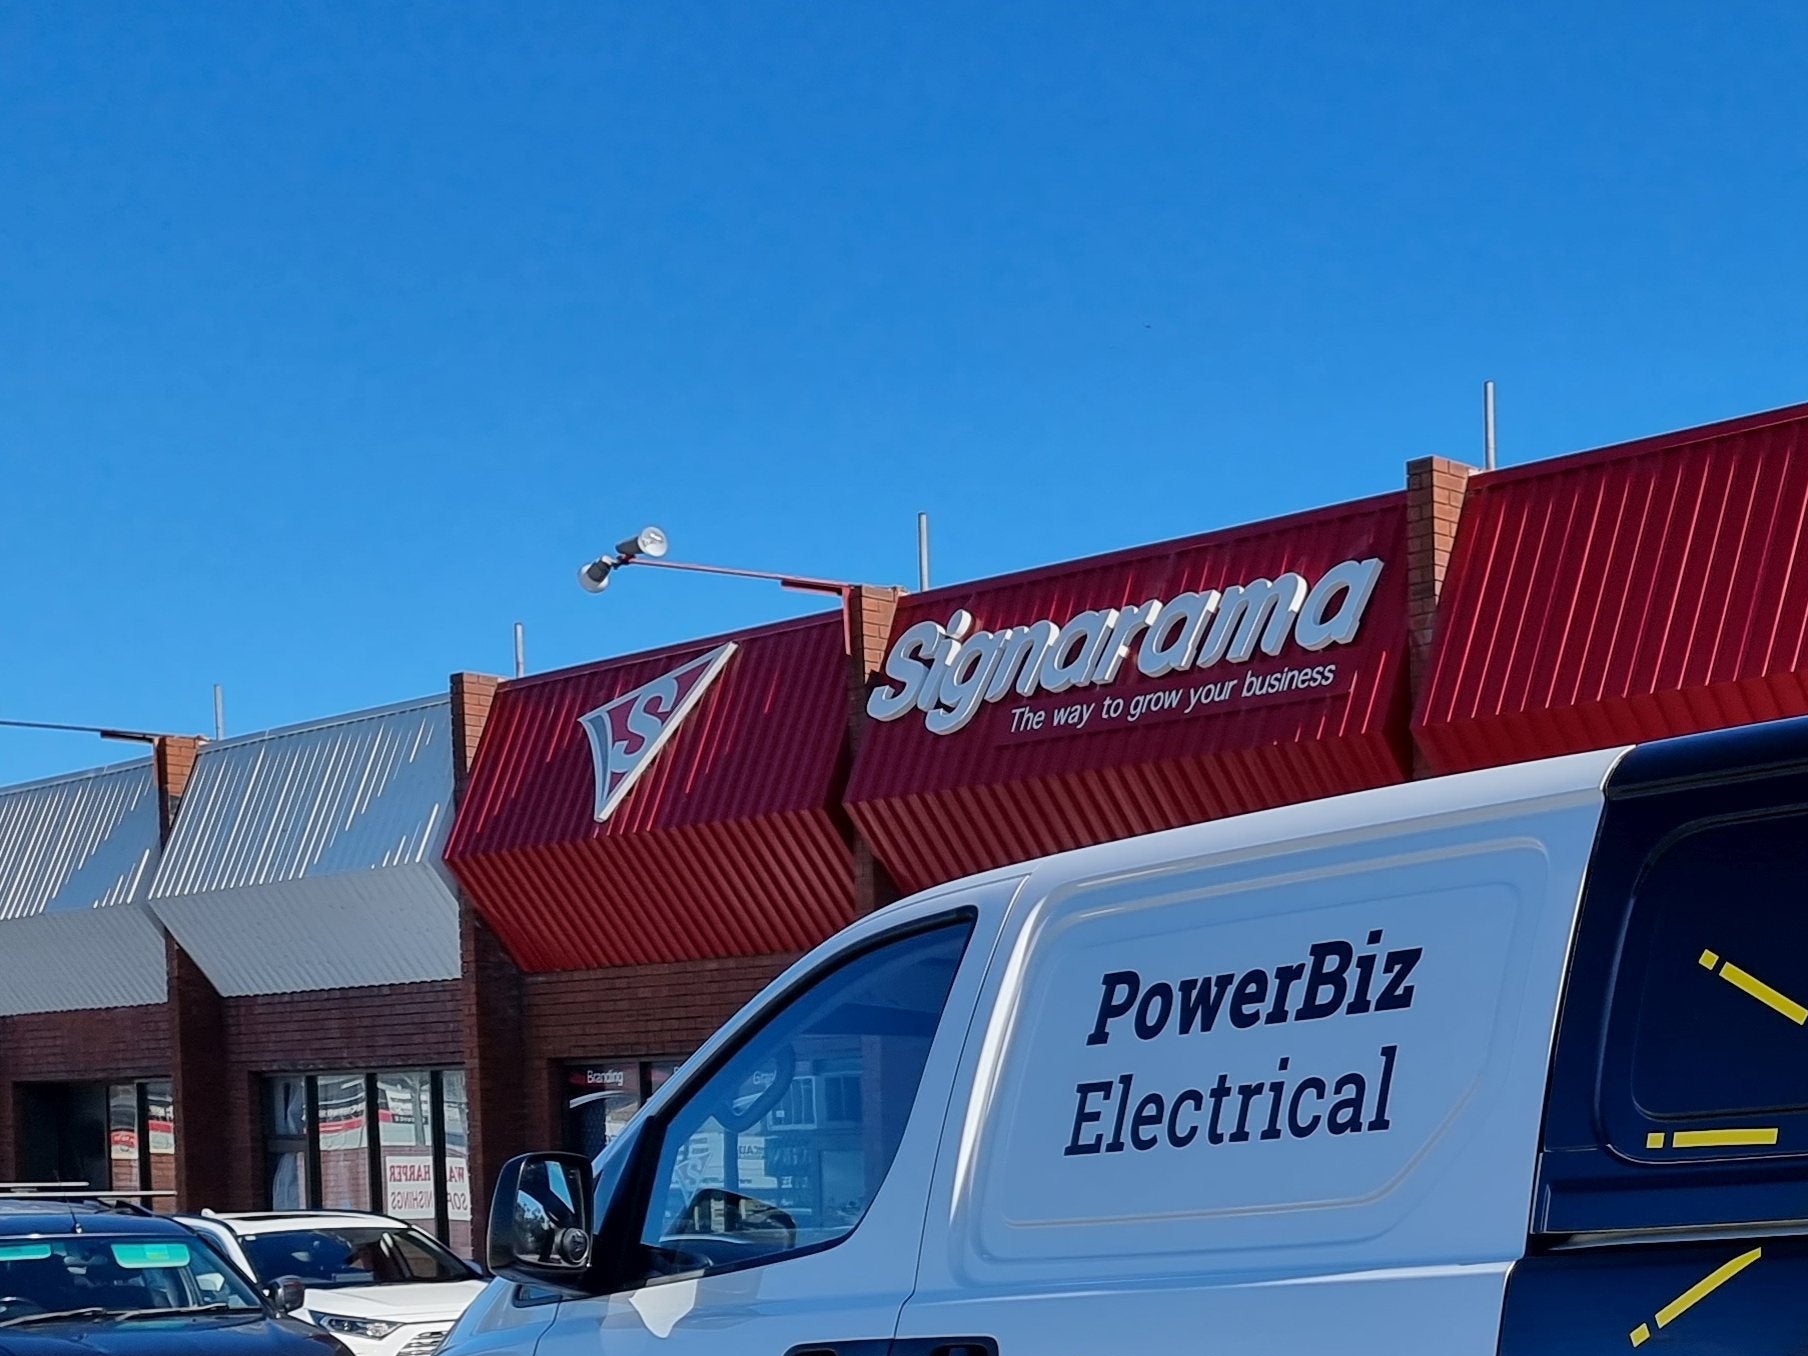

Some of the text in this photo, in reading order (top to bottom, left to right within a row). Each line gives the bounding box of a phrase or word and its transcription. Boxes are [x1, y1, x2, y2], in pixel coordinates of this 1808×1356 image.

[867, 557, 1384, 735] Signarama
[1010, 664, 1336, 733] The way to grow your business
[1086, 929, 1423, 1045] PowerBiz
[587, 1069, 623, 1086] Branding
[1063, 1045, 1398, 1157] Electrical
